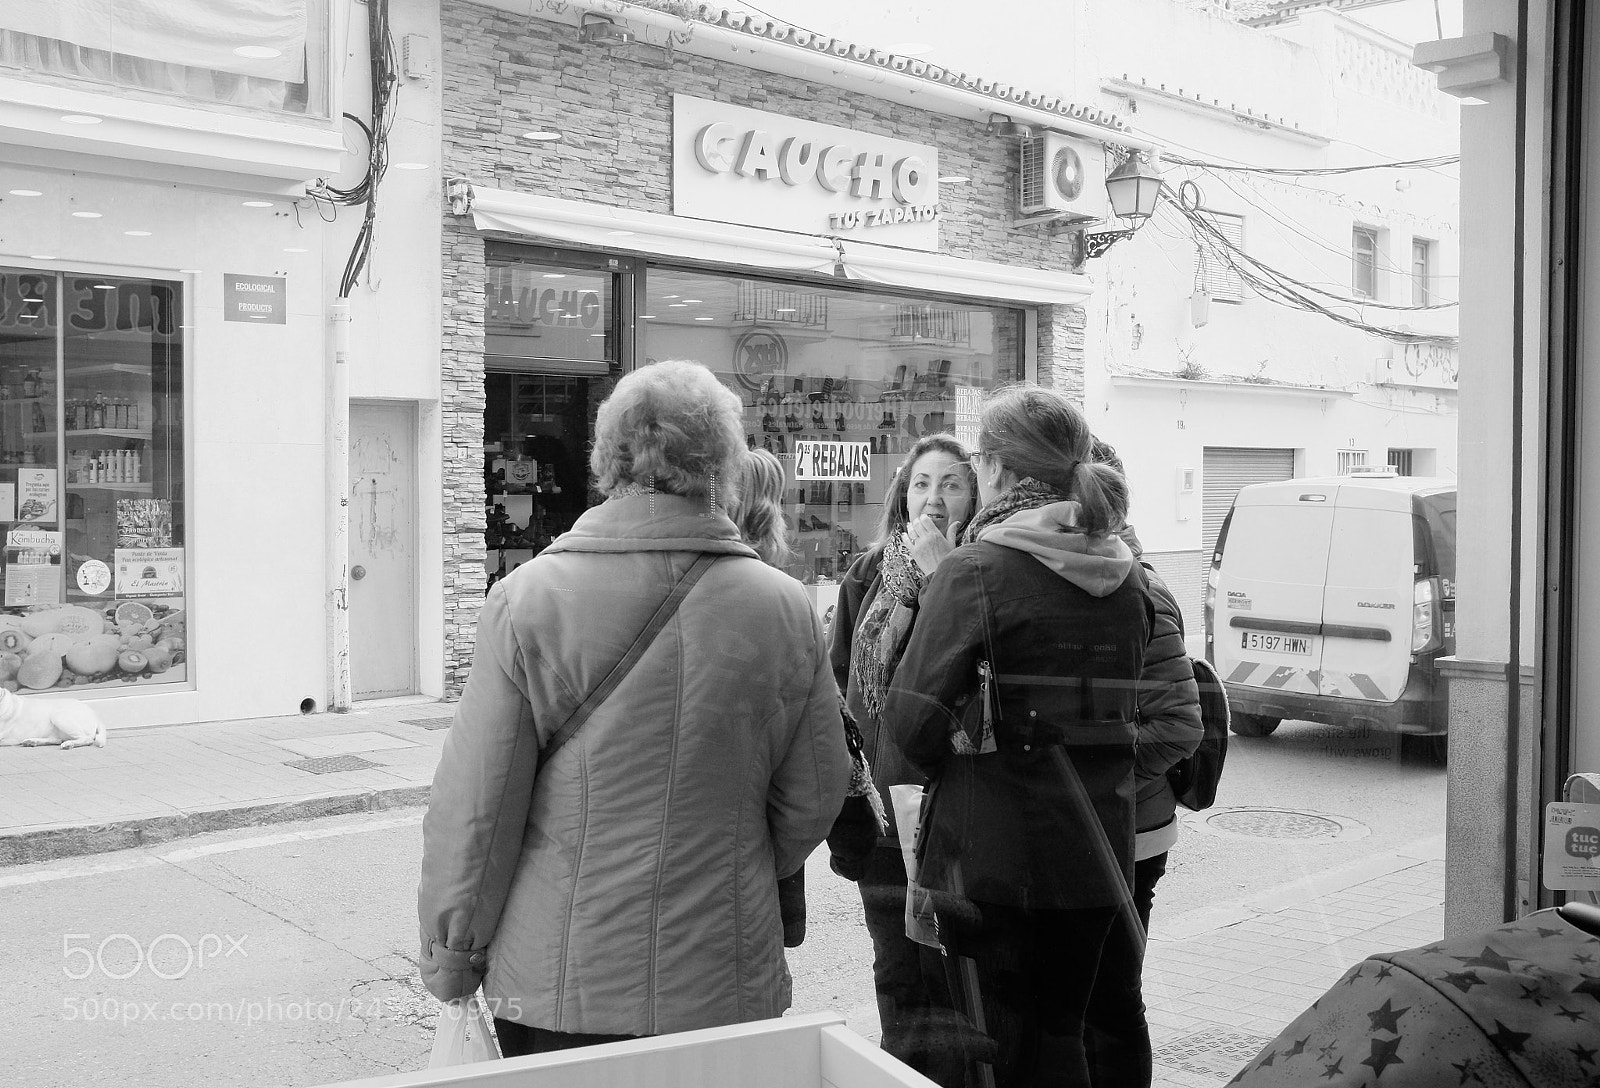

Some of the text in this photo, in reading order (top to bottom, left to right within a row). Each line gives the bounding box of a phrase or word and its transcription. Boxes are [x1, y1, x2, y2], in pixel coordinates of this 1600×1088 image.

[695, 121, 928, 205] CAUCHO
[829, 204, 944, 229] TUS ZAPATOS
[235, 282, 275, 293] ECOLOGICAL
[238, 302, 273, 313] PRODUCTS
[812, 443, 869, 477] REBAJAS
[10, 531, 56, 546] Kombucha
[1251, 634, 1307, 653] 5197 HWN
[1571, 832, 1599, 844] tuc
[1571, 843, 1598, 854] tuc
